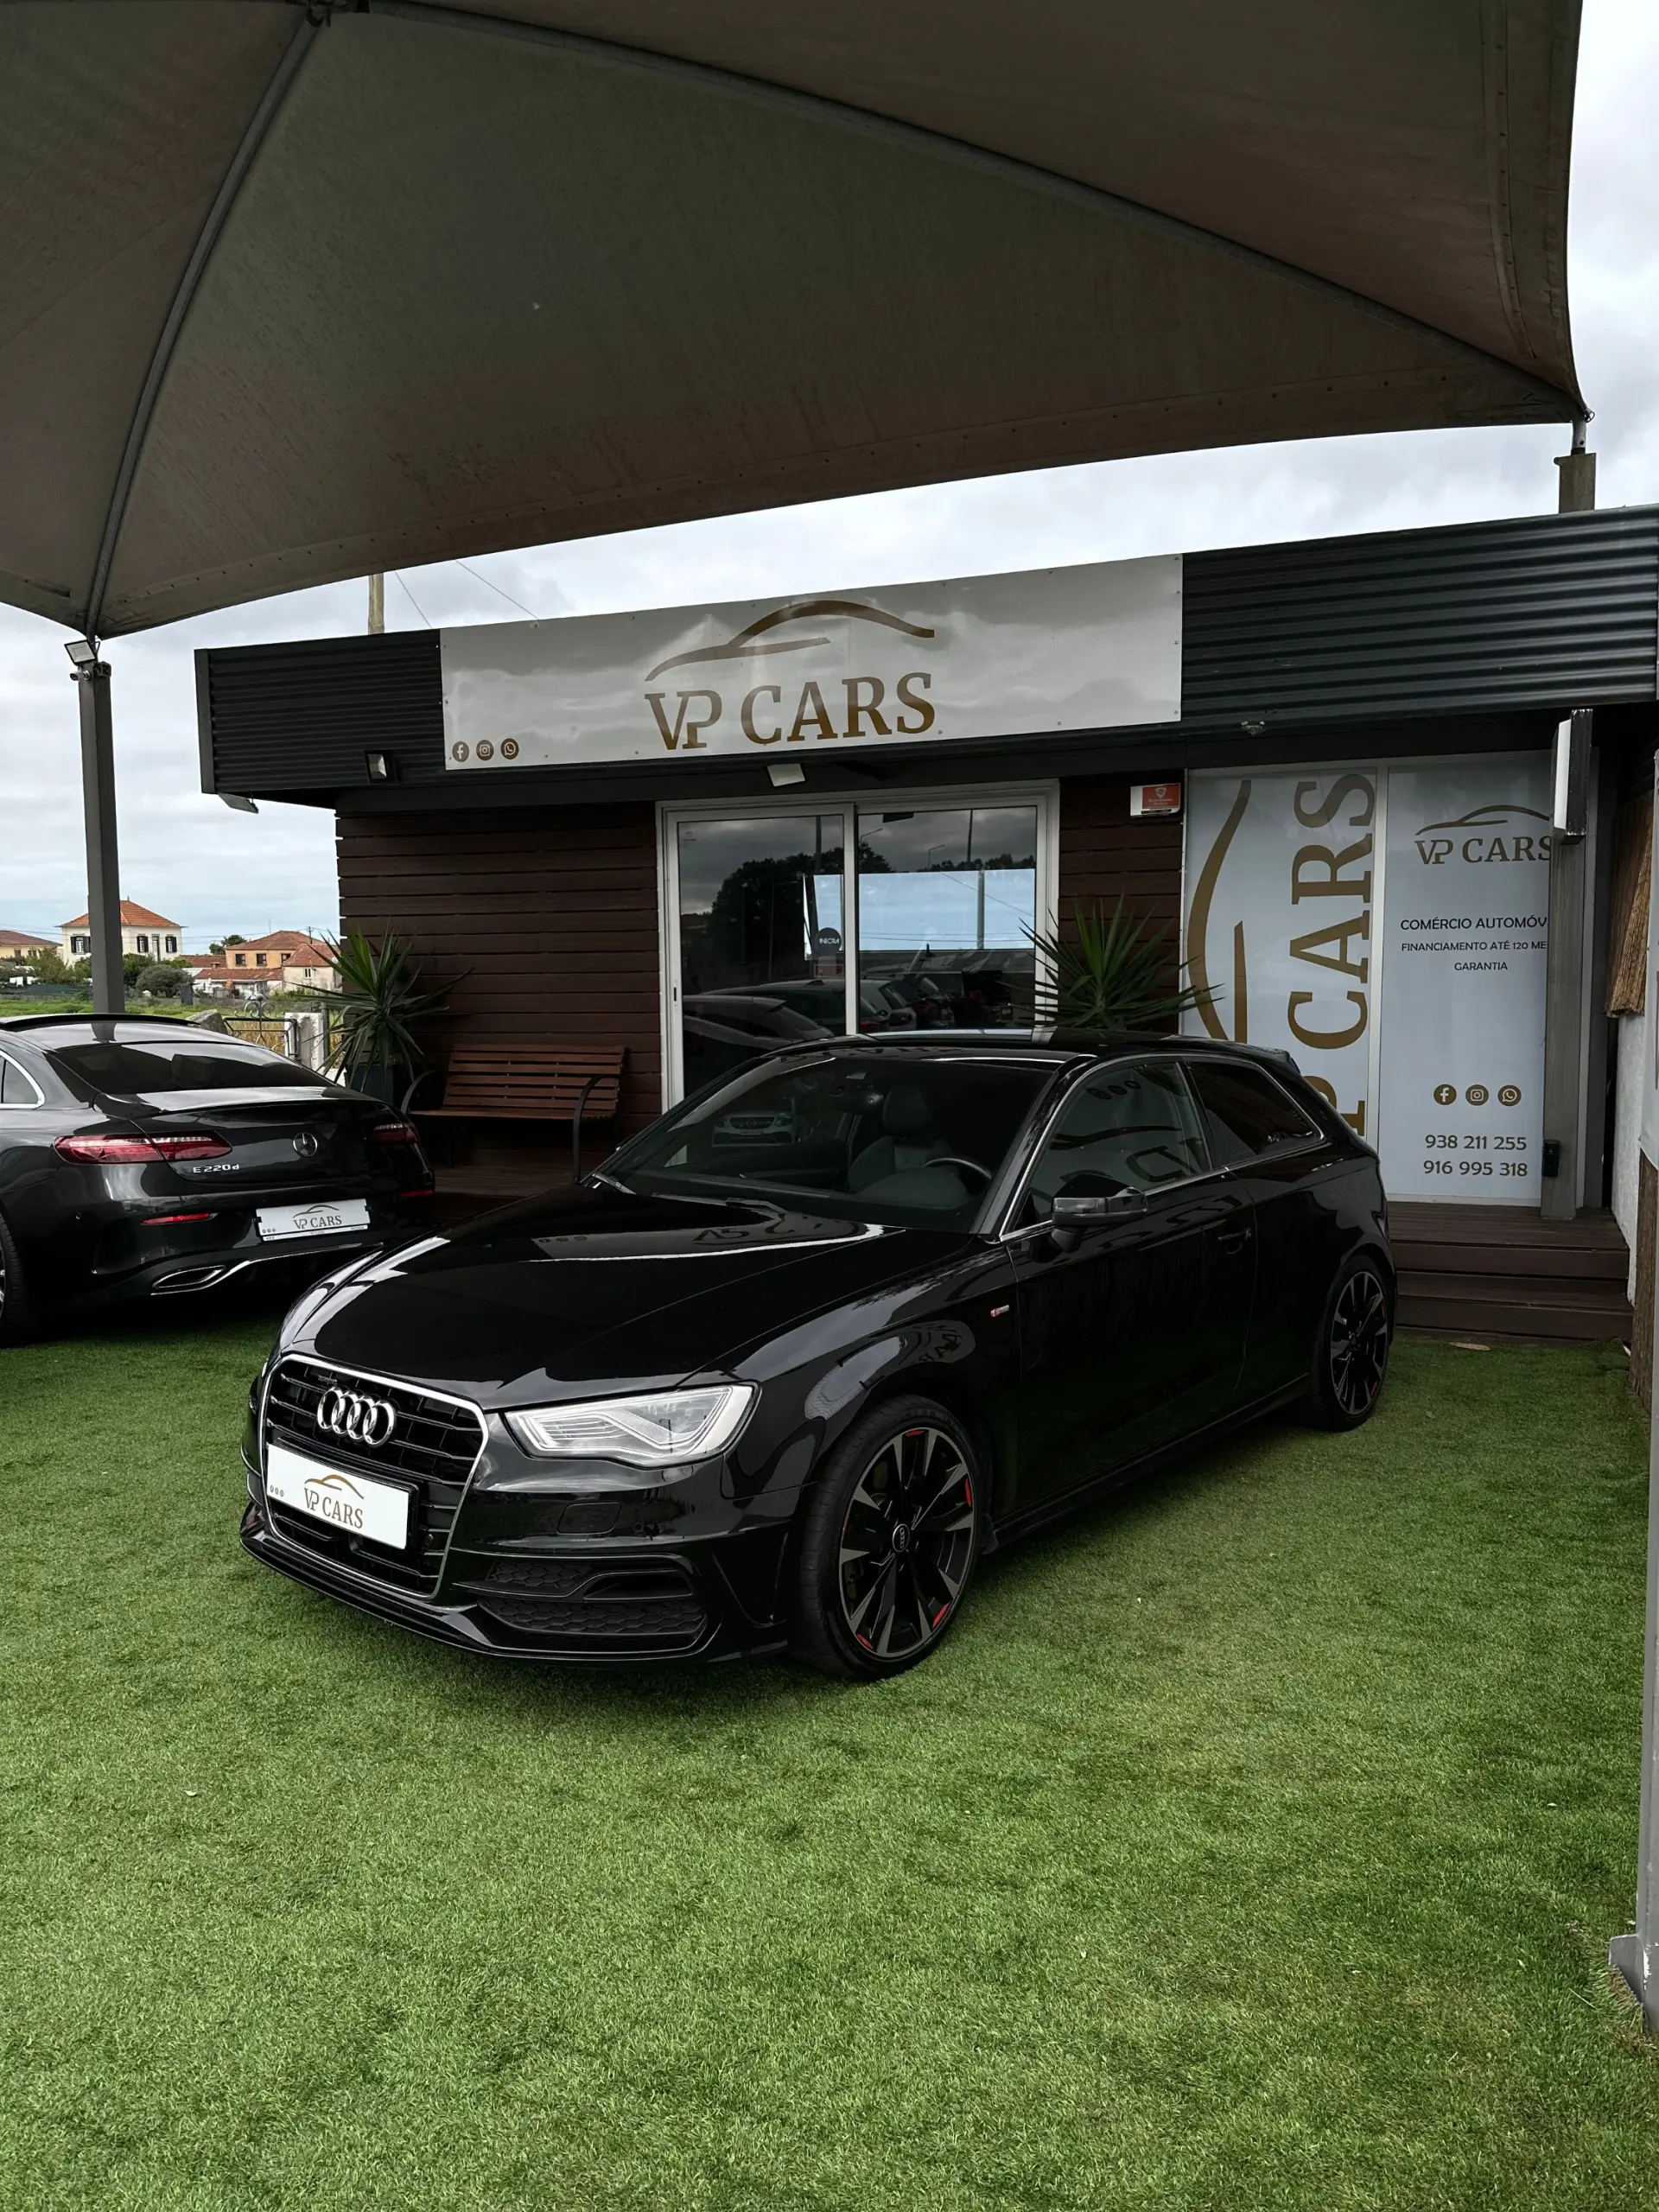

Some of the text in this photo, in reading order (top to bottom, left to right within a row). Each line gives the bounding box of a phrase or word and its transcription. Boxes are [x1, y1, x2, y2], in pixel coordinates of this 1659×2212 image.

[645, 671, 935, 751] VP CARS
[1414, 835, 1552, 865] VP CARS
[1287, 772, 1376, 1050] CARS
[1400, 916, 1472, 931] COMÉRCIO
[1401, 941, 1488, 951] FINANCIAMENTO
[1490, 939, 1510, 950] ATÉ
[1512, 941, 1529, 950] 120
[1453, 961, 1508, 971] GARANTIA
[1424, 1134, 1527, 1151] 938 211 255
[1423, 1160, 1528, 1177] 916 995 318
[293, 1214, 342, 1230] VP CARS
[303, 1487, 364, 1529] VP CARS
